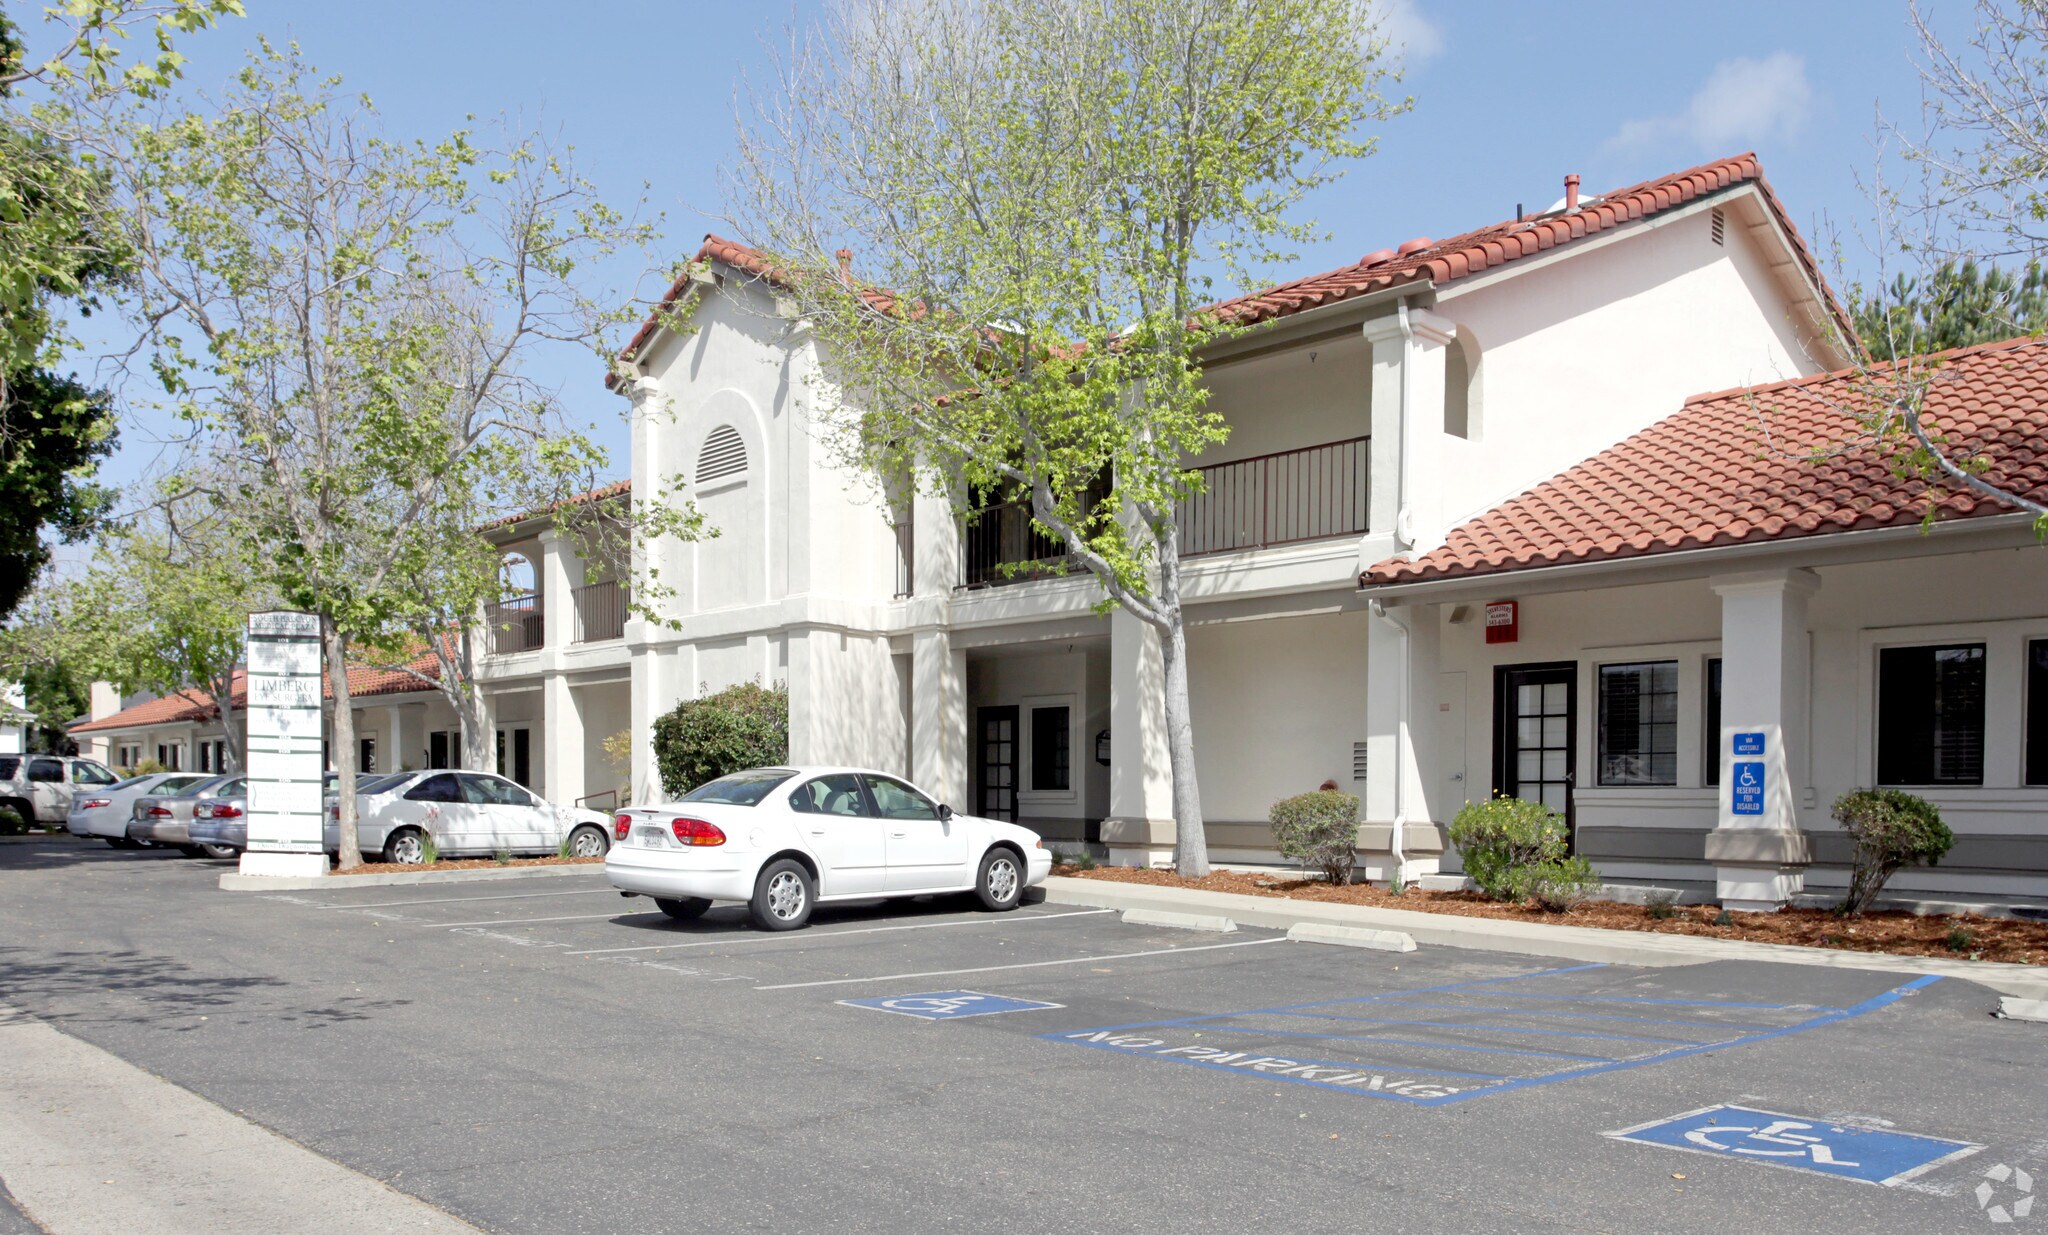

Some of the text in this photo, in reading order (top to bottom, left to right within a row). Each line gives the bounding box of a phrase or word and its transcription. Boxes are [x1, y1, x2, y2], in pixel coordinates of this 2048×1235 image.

[280, 615, 316, 623] HALCYON
[254, 680, 314, 692] LIMBERG
[254, 693, 270, 701] EYE
[1065, 1030, 1460, 1098] NO PARKING
